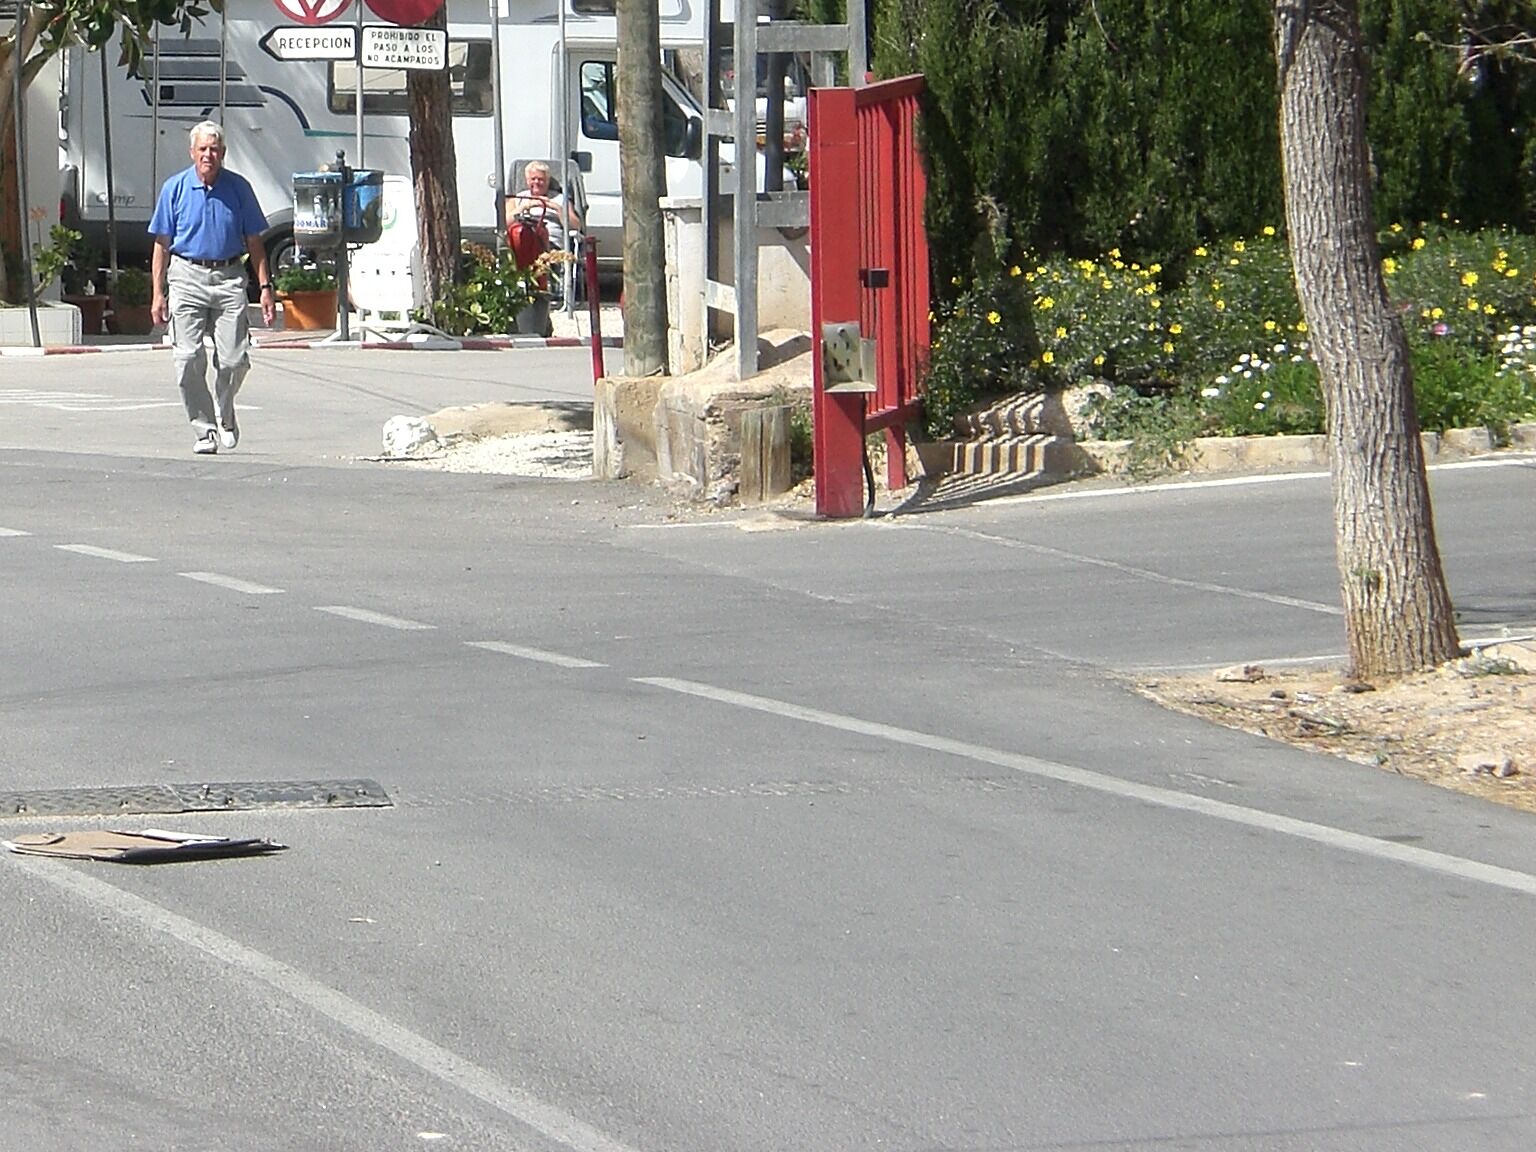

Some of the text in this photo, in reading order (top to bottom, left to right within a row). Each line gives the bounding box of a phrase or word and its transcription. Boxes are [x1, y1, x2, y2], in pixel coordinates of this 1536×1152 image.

[371, 31, 437, 42] PROHIBIDO EL
[279, 36, 352, 49] RECEPCION
[373, 43, 434, 53] PASO A LOS
[384, 55, 440, 65] ACAMPADOS
